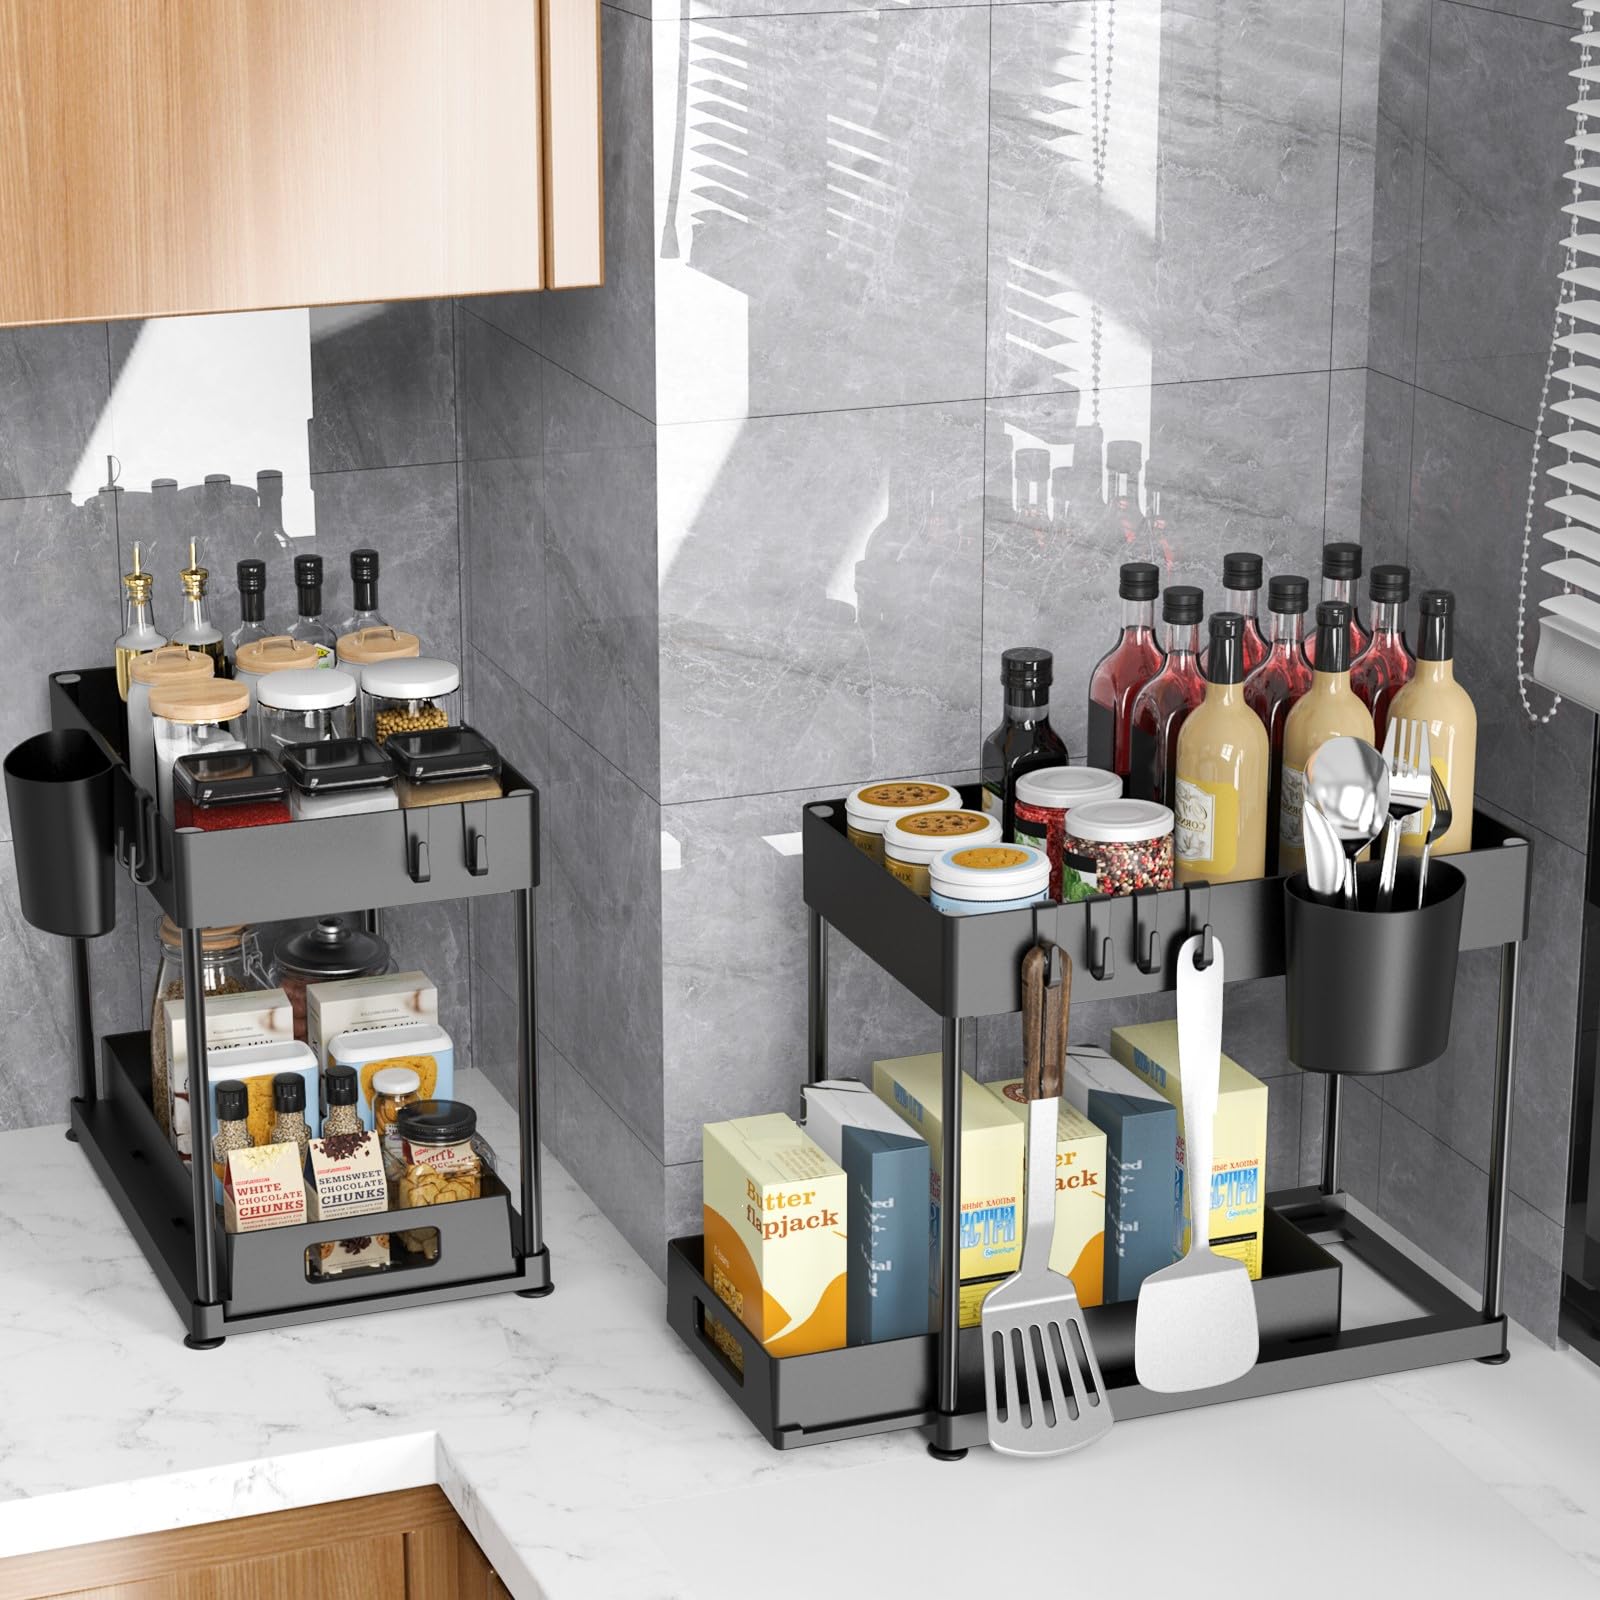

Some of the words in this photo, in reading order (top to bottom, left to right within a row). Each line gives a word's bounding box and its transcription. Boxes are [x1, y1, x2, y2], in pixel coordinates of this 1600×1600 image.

[318, 1169, 382, 1185] SEMISWEET
[236, 1182, 282, 1197] WHITE
[320, 1178, 384, 1194] CHOCOLATE
[238, 1190, 303, 1206] CHOCOLATE
[321, 1187, 385, 1205] CHUNKS
[746, 1178, 816, 1212] Butter
[239, 1199, 304, 1217] CHUNKS
[746, 1203, 839, 1240] flapjack
